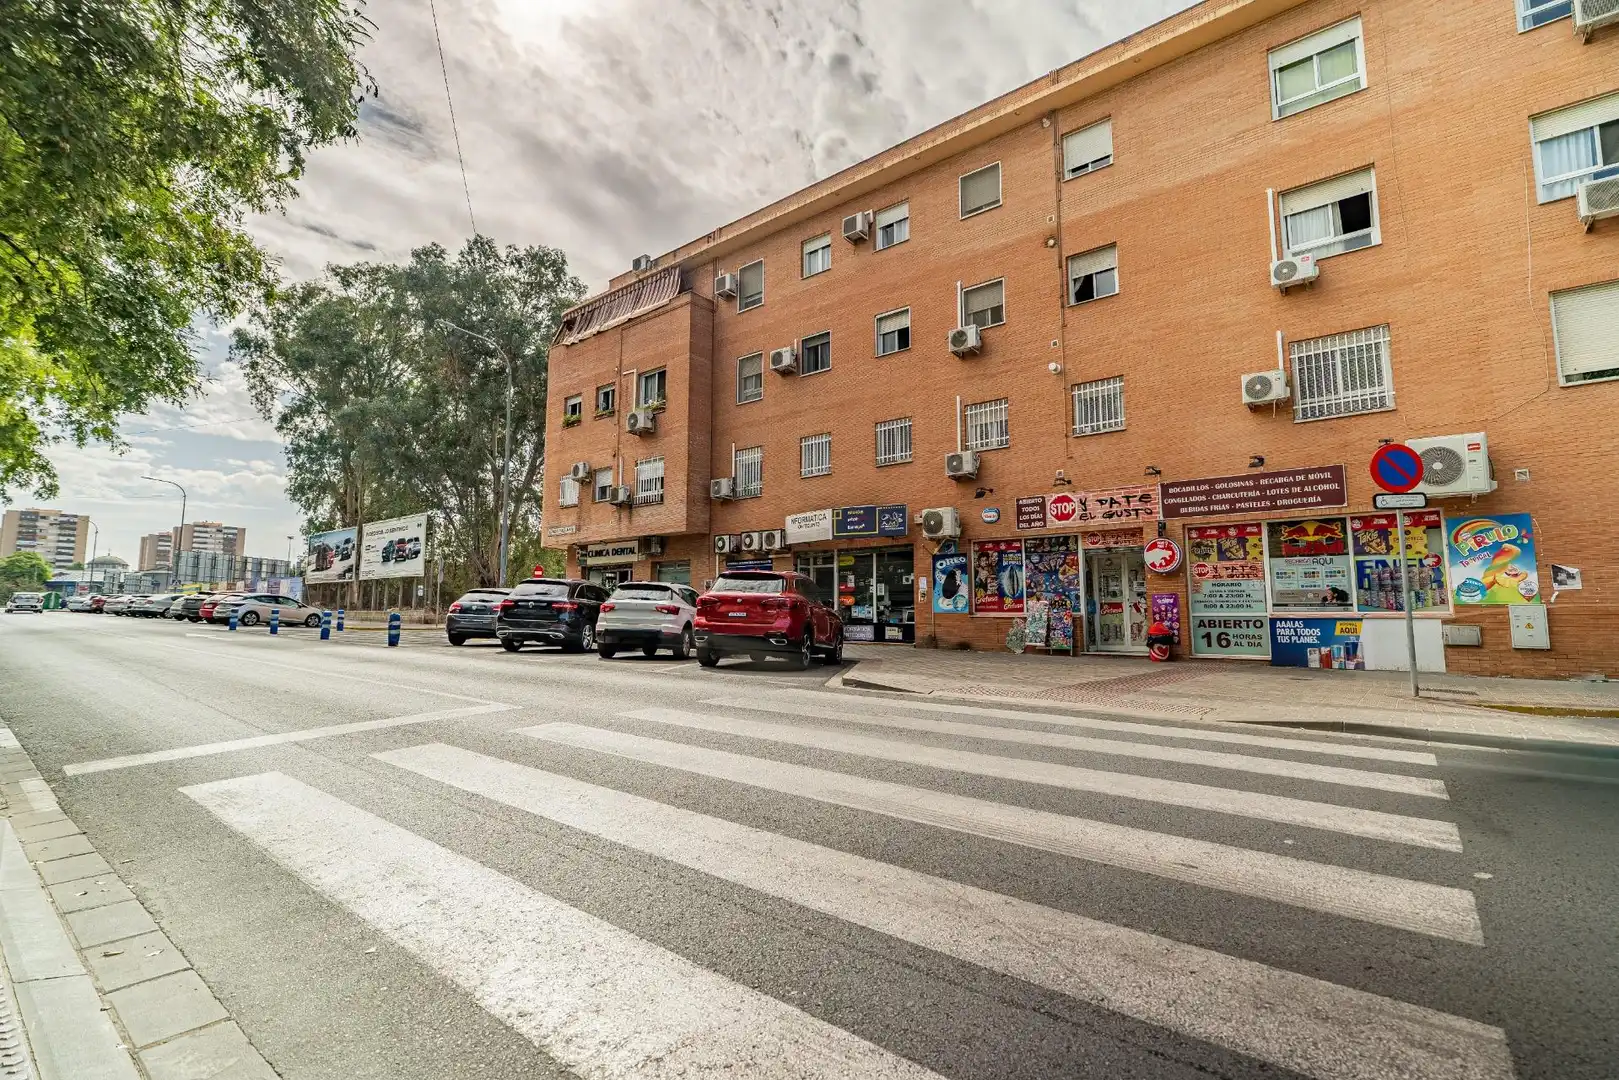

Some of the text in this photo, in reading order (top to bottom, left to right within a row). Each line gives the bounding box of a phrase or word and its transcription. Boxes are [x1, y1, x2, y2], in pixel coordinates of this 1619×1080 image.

[1168, 484, 1210, 493] BOCADILLOS
[1215, 480, 1254, 490] GOLOSINAS
[1260, 476, 1294, 485] RECARGA
[1308, 472, 1332, 480] MÓVIL
[1164, 495, 1206, 504] CONGELADOS
[1212, 489, 1260, 500] CHARCUTERÍA
[1304, 482, 1340, 492] ALCOHOL
[1050, 503, 1076, 515] STOP
[1079, 498, 1087, 511] Y
[1180, 506, 1208, 514] BEBIDAS
[1236, 500, 1270, 509] PASTELES
[1277, 496, 1322, 506] DROGUERÍA
[1079, 508, 1153, 521] EL GUSTO
[1357, 531, 1380, 545] Takis
[1455, 525, 1518, 556] PIRULO
[612, 547, 636, 556] DENTAL
[936, 556, 966, 569] OREO
[1459, 551, 1491, 568] TROPICAL
[1198, 619, 1263, 629] ABIERTO
[1201, 632, 1231, 649] 16
